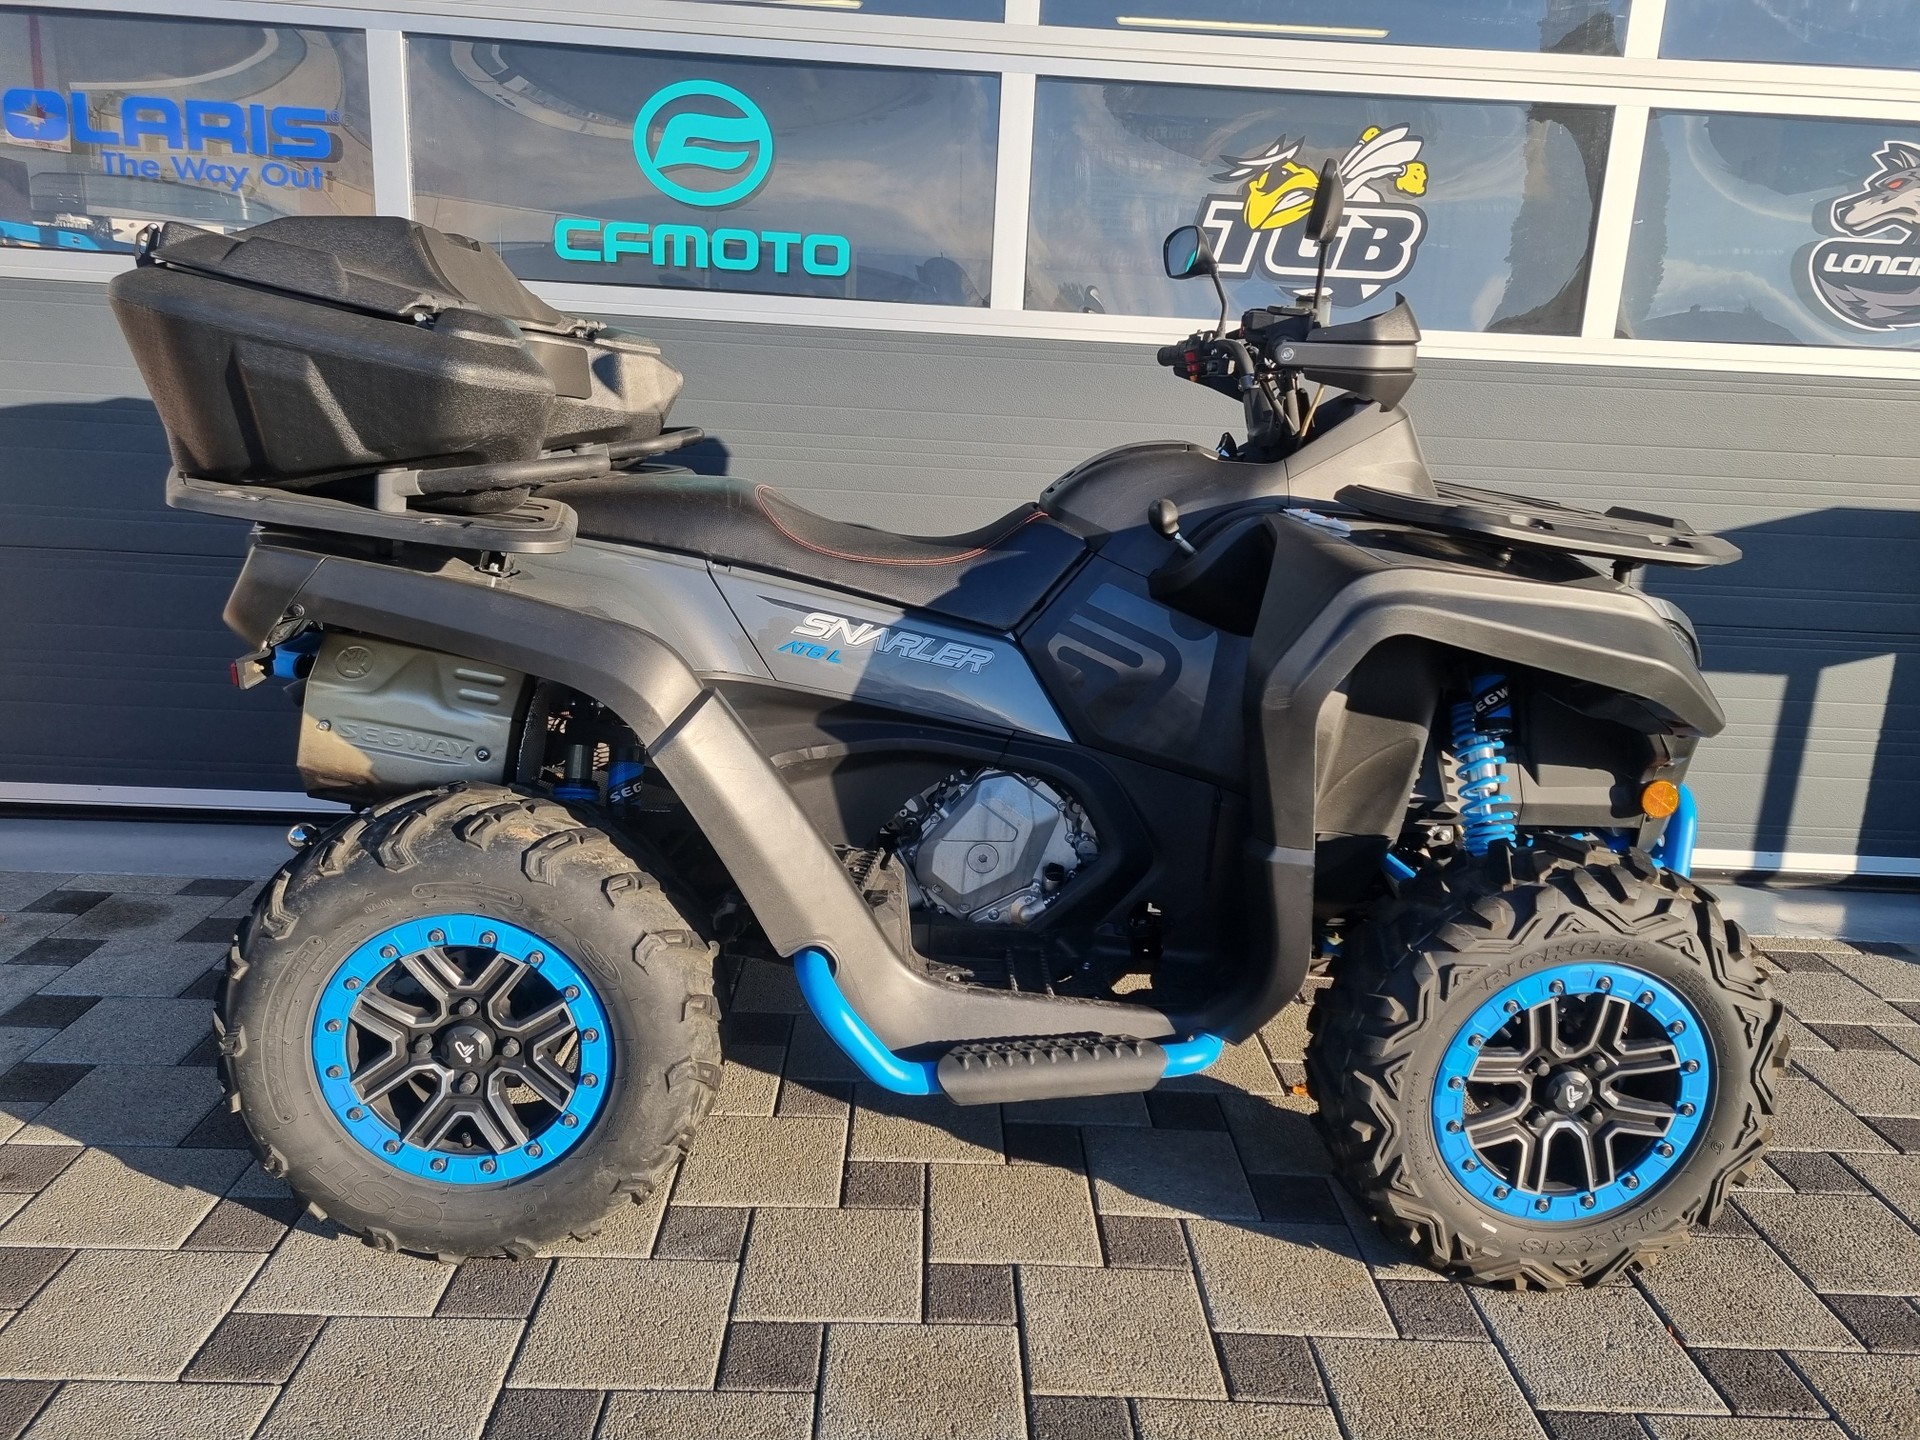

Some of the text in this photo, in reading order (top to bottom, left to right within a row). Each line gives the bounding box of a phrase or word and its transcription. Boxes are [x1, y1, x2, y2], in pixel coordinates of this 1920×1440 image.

[102, 151, 324, 191] The Way Out
[554, 218, 850, 277] CFMOTO
[1823, 253, 1920, 276] LONCI
[791, 612, 996, 674] SNARLER
[338, 723, 471, 759] SEGWAY
[609, 780, 643, 803] SEG
[308, 1162, 445, 1228] CST
